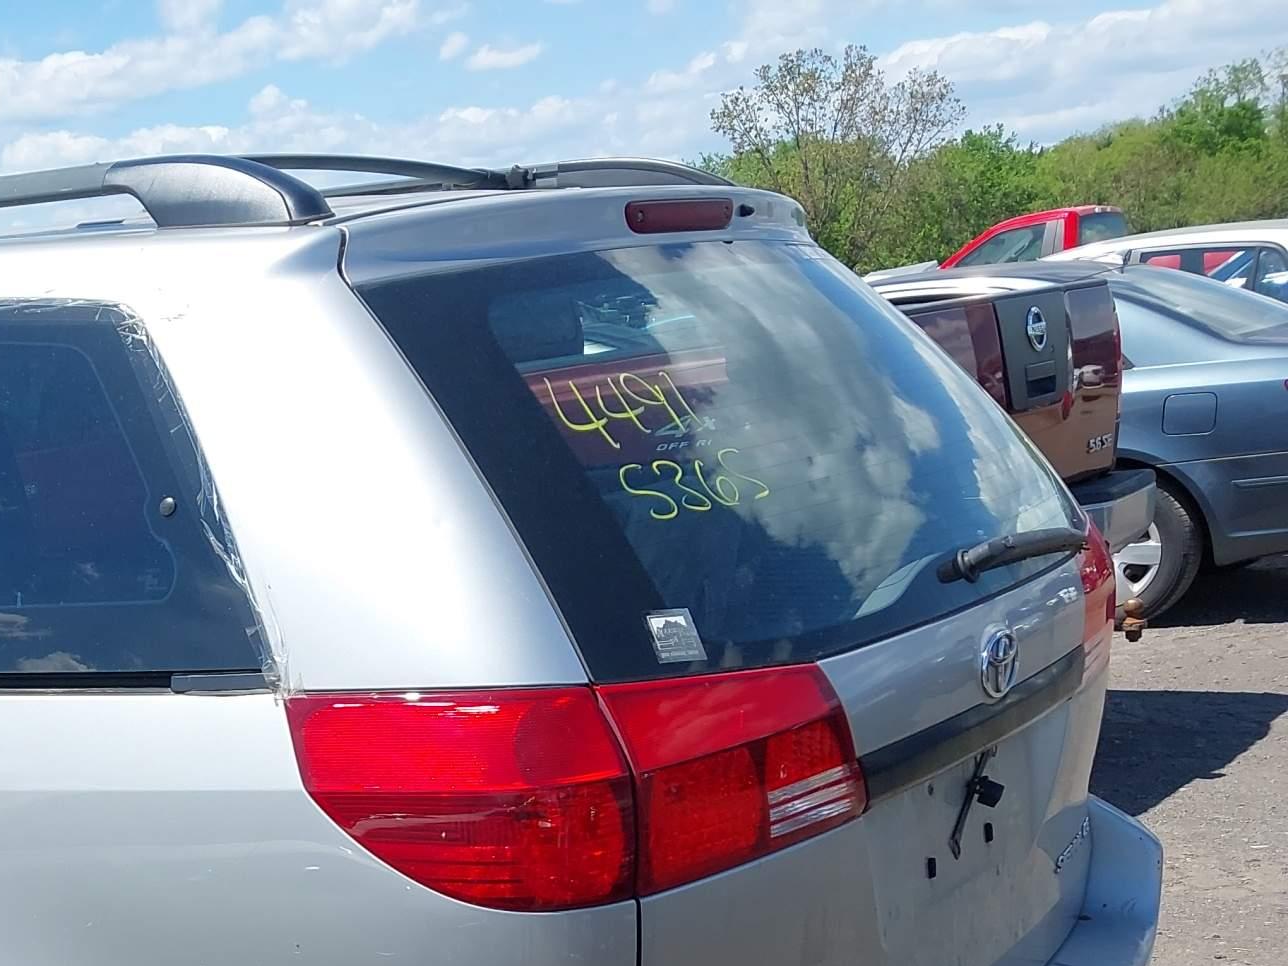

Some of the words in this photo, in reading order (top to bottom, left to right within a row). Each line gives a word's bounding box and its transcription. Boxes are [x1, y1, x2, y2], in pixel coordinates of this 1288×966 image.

[543, 370, 702, 449] 4491
[655, 440, 690, 451] OFF
[618, 448, 771, 520] 5365
